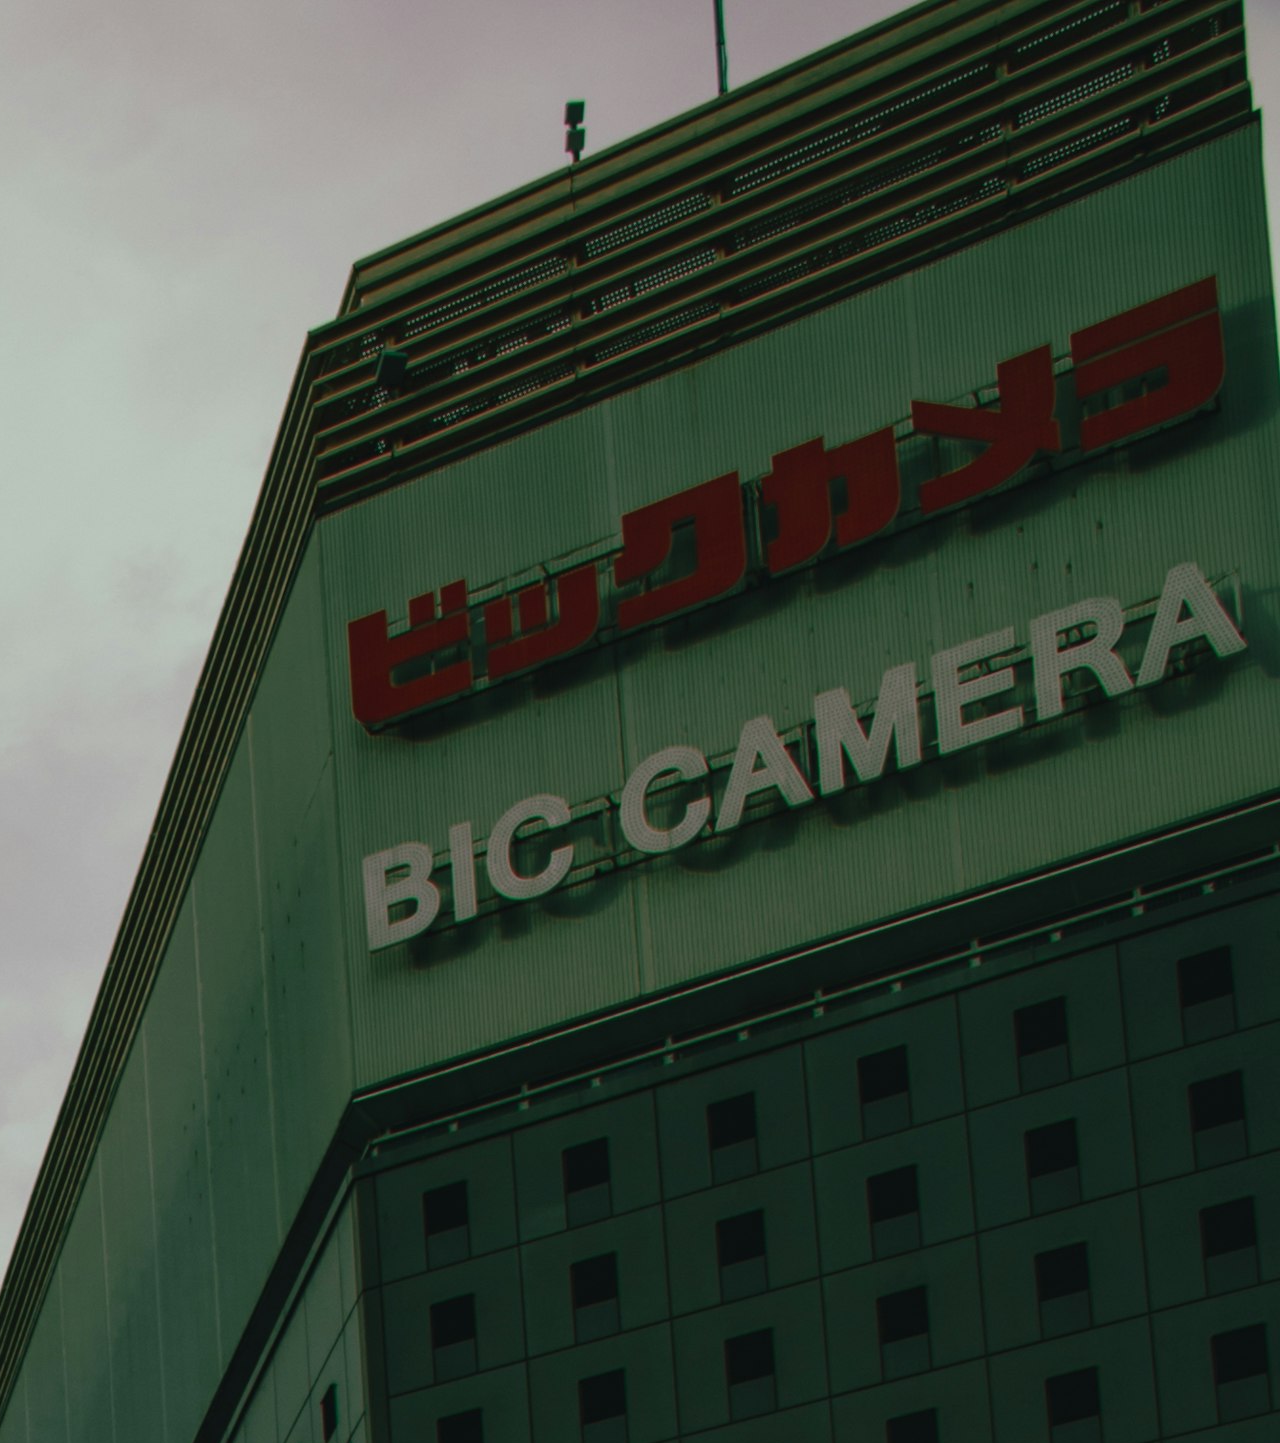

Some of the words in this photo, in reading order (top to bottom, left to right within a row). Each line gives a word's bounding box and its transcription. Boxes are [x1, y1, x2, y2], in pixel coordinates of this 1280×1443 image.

[348, 274, 1226, 728] ビックカメラ
[362, 792, 574, 952] BIC
[619, 562, 1246, 854] CAMERA
